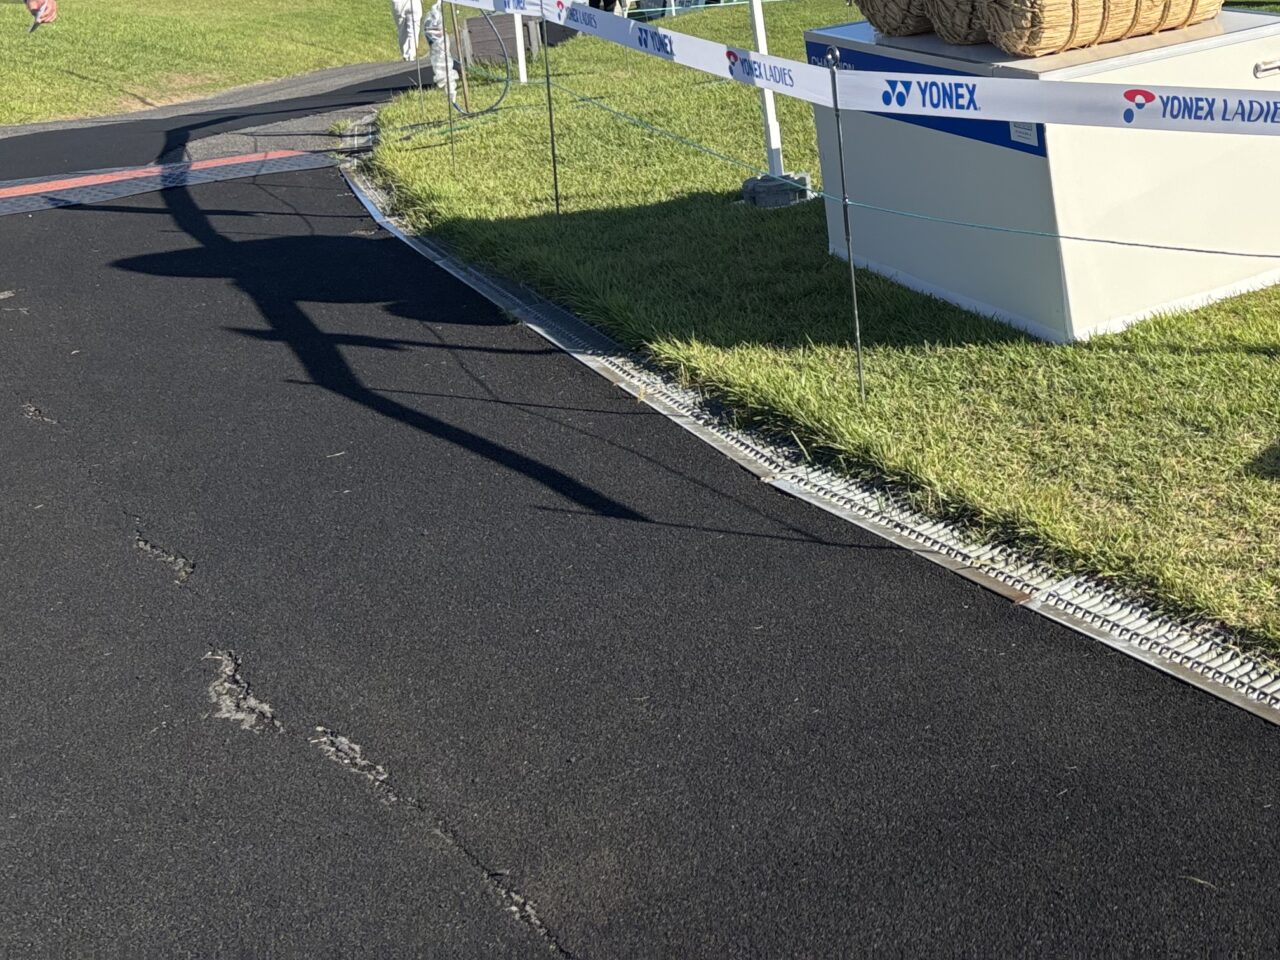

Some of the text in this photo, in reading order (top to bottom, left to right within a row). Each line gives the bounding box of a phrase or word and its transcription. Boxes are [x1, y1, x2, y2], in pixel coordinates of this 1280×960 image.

[580, 8, 597, 29] LADIES
[650, 32, 673, 56] YONEX
[739, 56, 794, 88] YONEX LADIES
[916, 80, 979, 111] YONEX
[1159, 95, 1217, 121] YONEX
